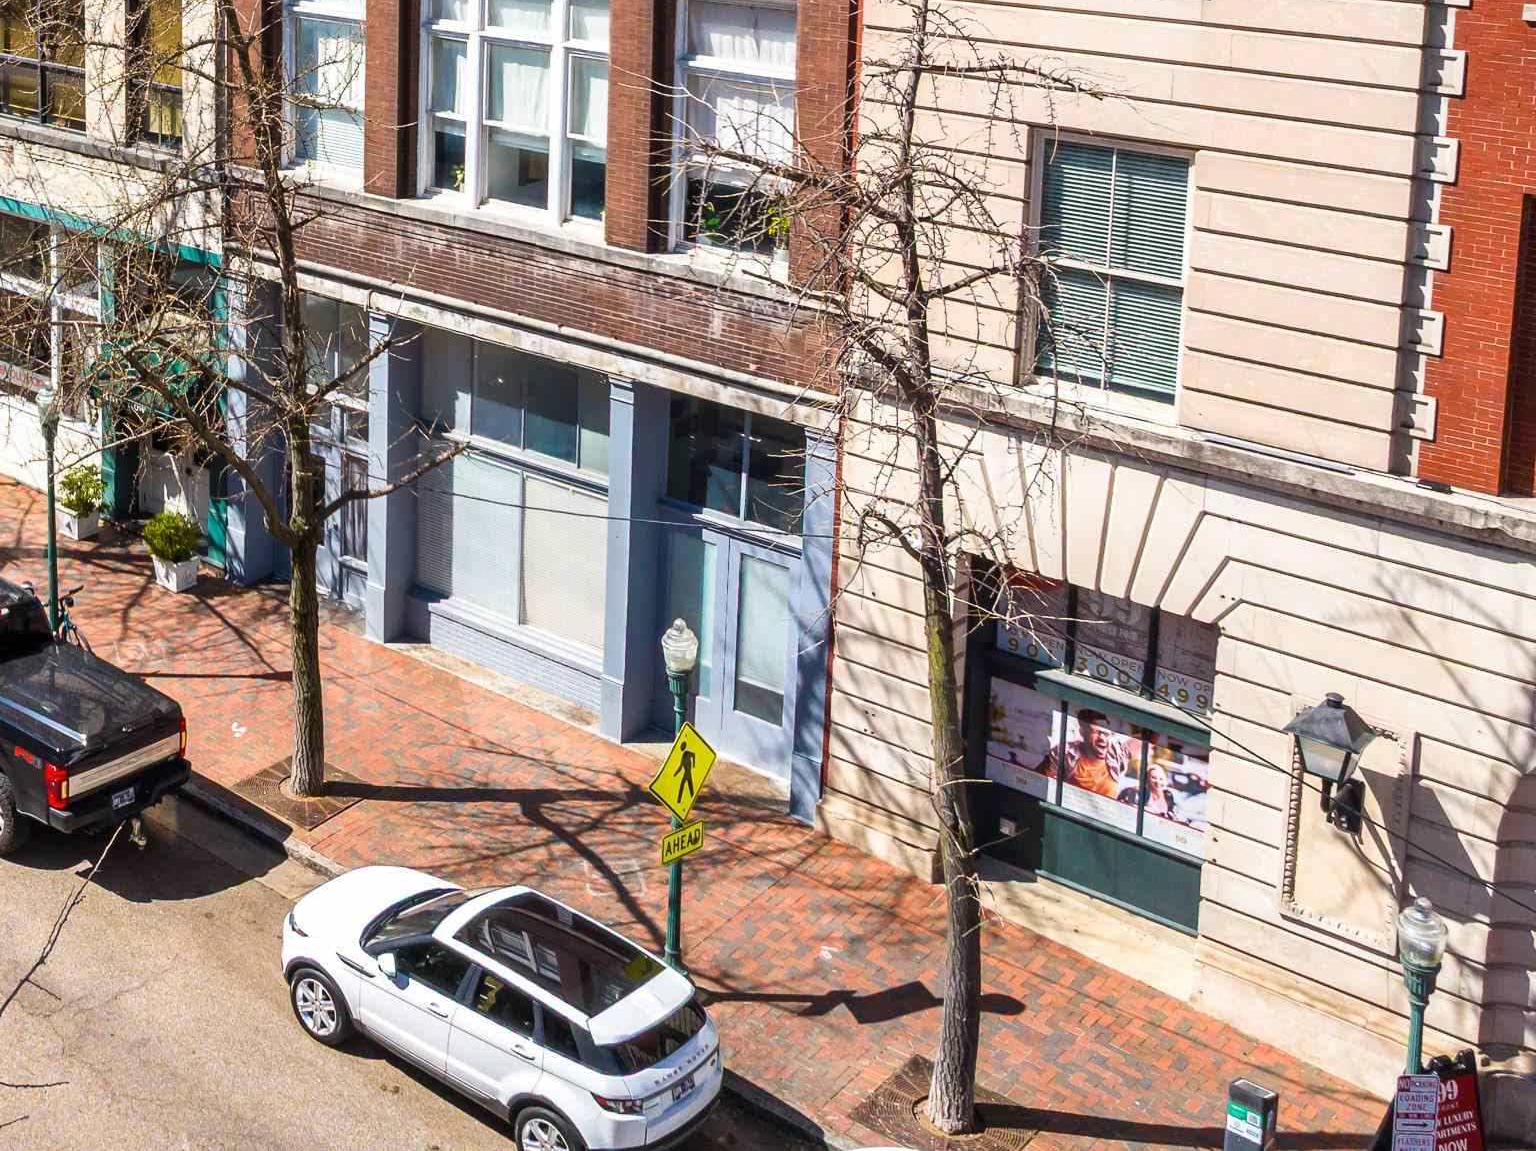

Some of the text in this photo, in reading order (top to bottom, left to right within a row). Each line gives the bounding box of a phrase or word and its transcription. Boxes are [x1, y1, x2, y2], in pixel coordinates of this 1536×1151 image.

[1110, 656, 1144, 674] OPEN
[1157, 670, 1188, 686] NOW
[665, 829, 701, 857] AHEAD
[1398, 1078, 1410, 1090] NO
[1444, 1110, 1473, 1125] LUXURY
[1438, 1138, 1468, 1151] NOW
